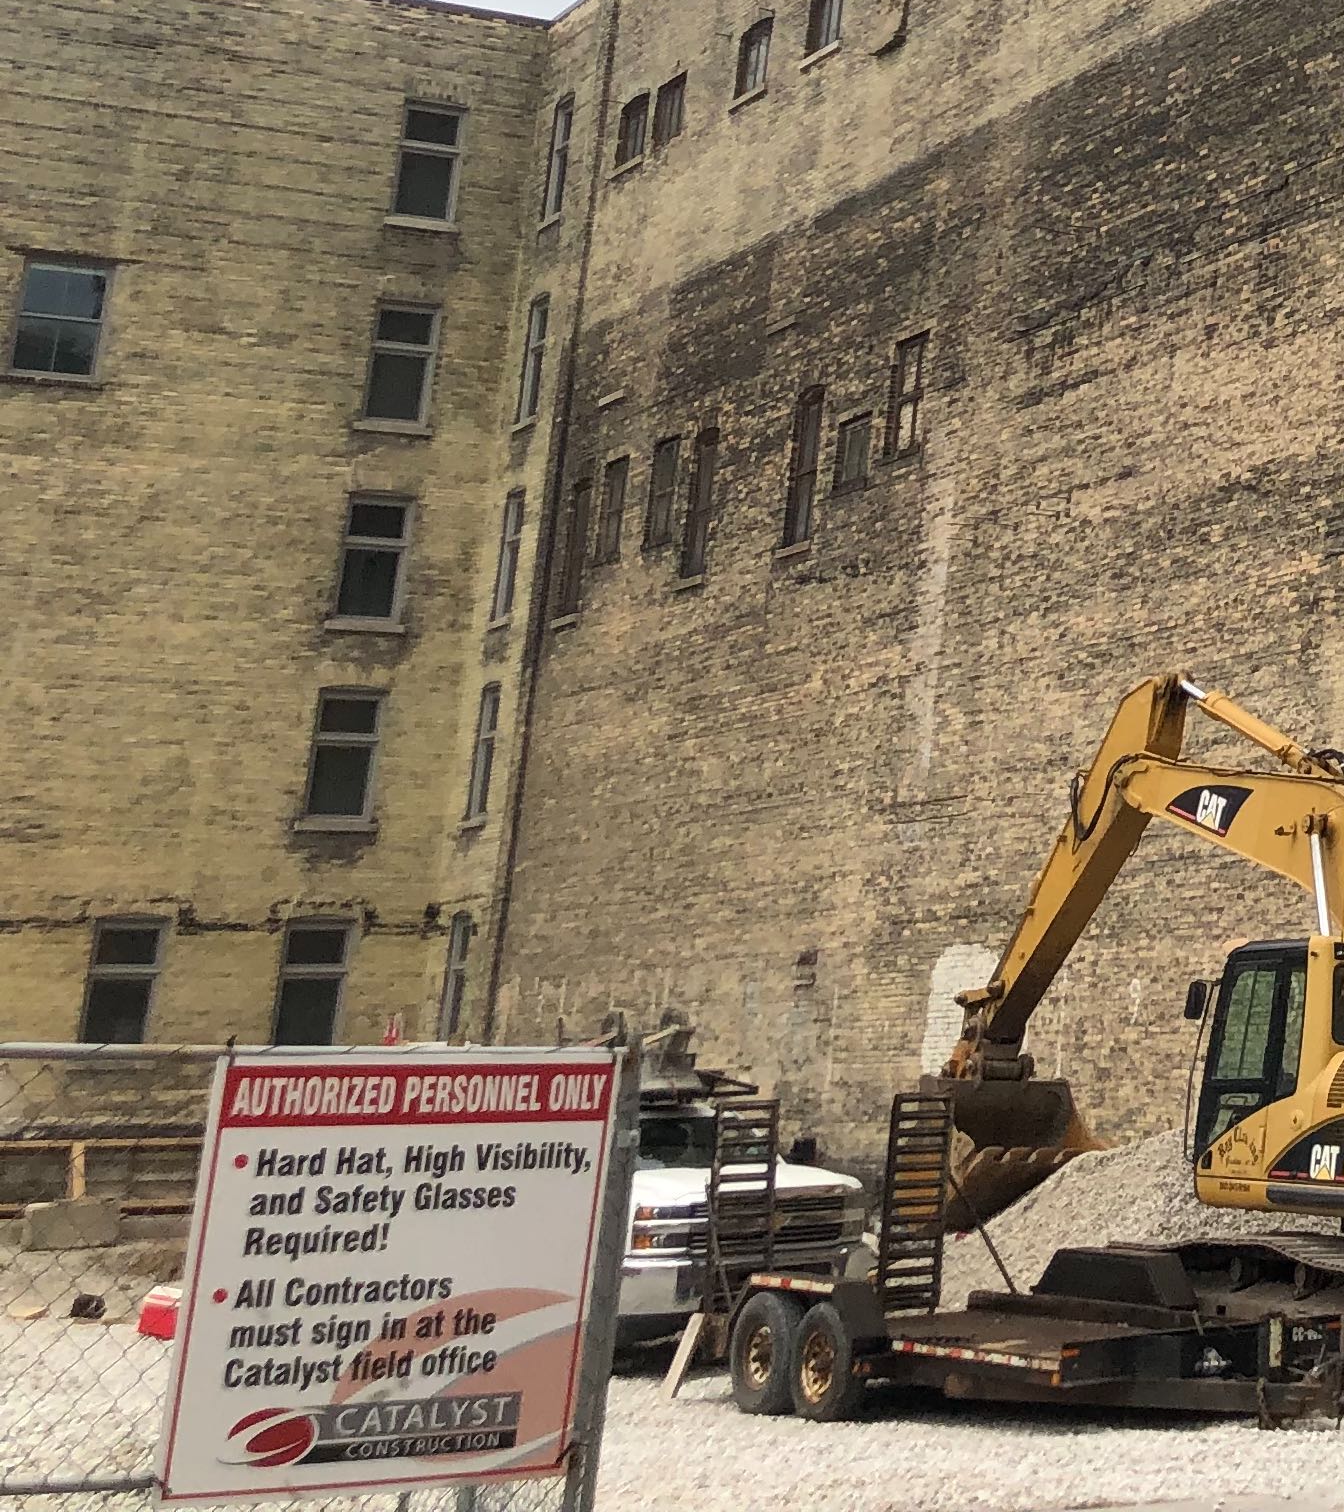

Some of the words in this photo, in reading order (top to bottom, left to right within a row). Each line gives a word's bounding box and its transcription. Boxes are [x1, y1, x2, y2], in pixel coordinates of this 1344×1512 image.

[1196, 789, 1227, 830] CAT
[232, 1076, 397, 1116] AUTHORIZED
[403, 1075, 542, 1113] PERSONNEL
[549, 1074, 607, 1111] ONLY
[256, 1147, 327, 1176] Hard
[336, 1147, 393, 1179] Hat,
[404, 1144, 465, 1178] High
[476, 1142, 592, 1175] Visibility,
[1309, 1144, 1340, 1180] CAT
[250, 1187, 306, 1216] and
[314, 1184, 406, 1218] Safety
[415, 1183, 516, 1211] Glasses
[243, 1223, 390, 1262] Required!
[234, 1278, 276, 1309] All
[285, 1274, 453, 1307] Contractors
[229, 1318, 302, 1349] must
[311, 1314, 370, 1349] sign
[381, 1312, 406, 1339] in
[415, 1312, 444, 1338] at
[453, 1308, 496, 1336] the
[225, 1354, 342, 1391] Catalyst
[351, 1350, 414, 1381] field
[422, 1345, 497, 1375] office
[336, 1397, 512, 1436] CATALYST
[345, 1433, 500, 1458] CONSTRUCTION
